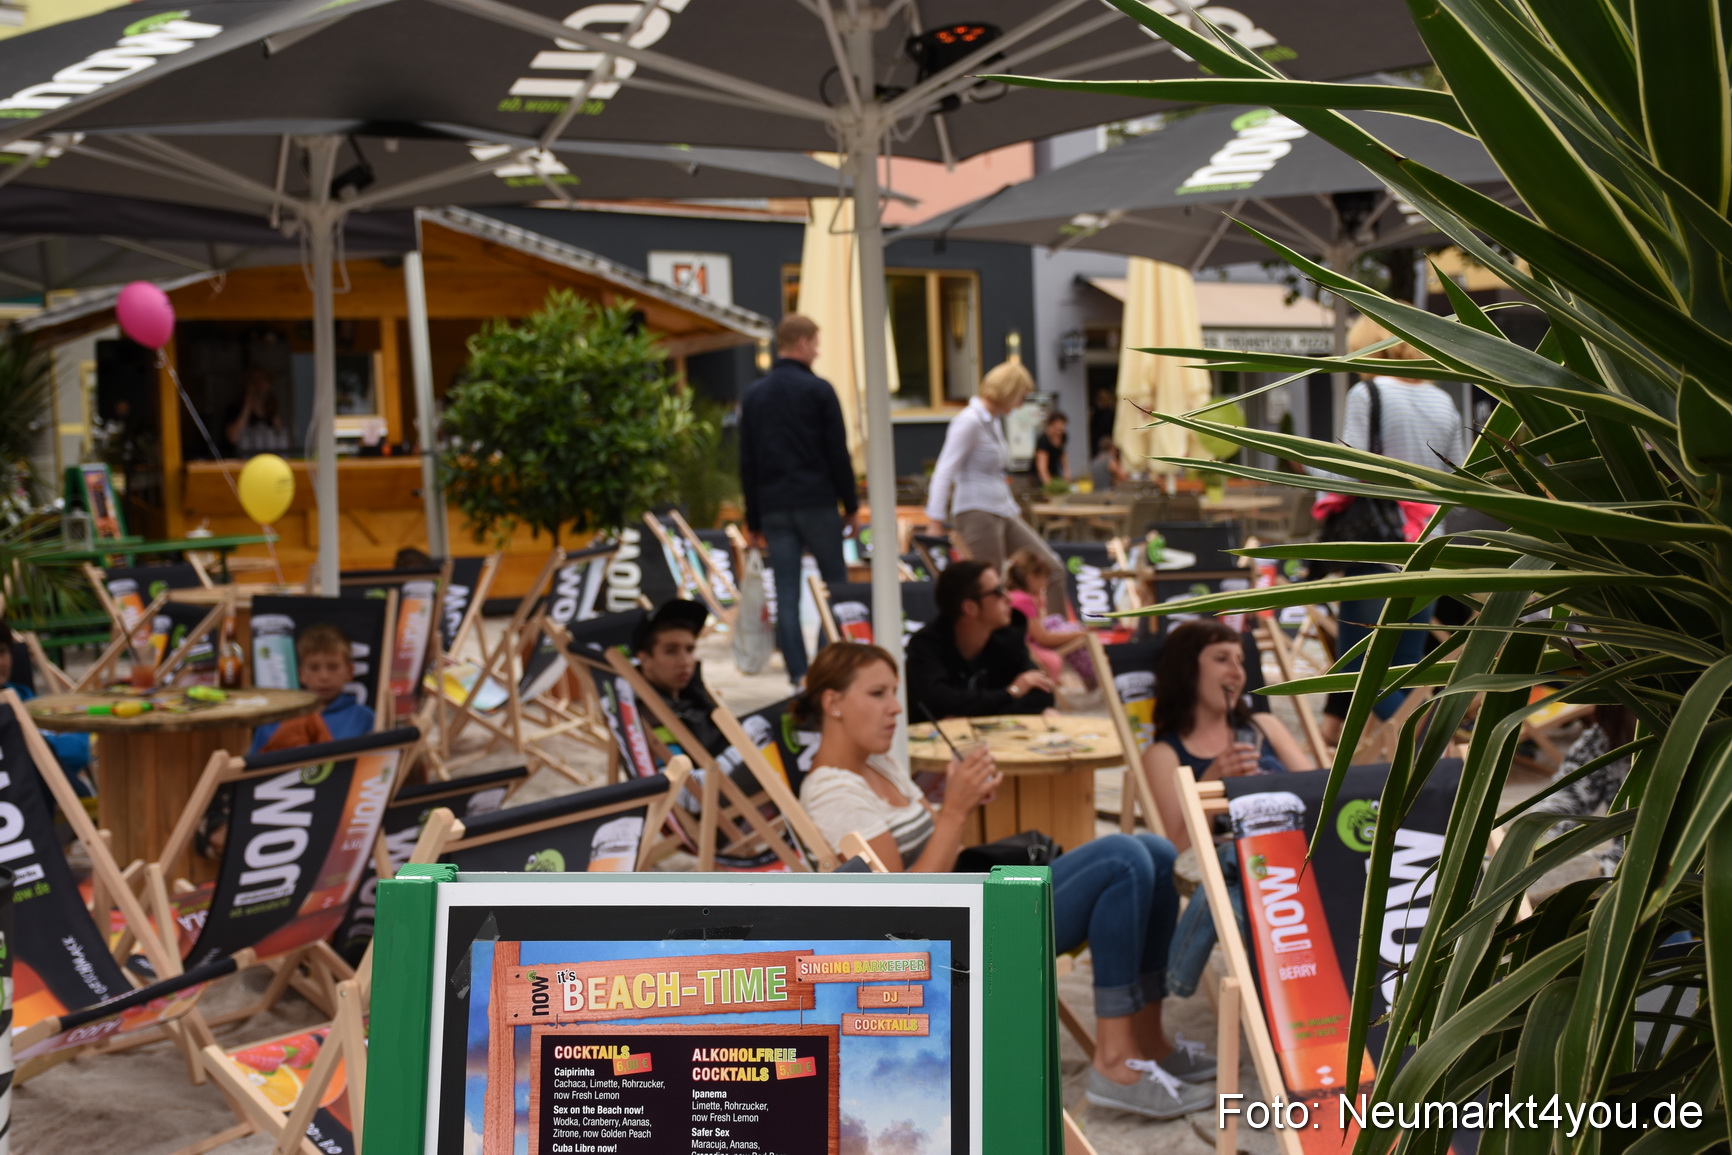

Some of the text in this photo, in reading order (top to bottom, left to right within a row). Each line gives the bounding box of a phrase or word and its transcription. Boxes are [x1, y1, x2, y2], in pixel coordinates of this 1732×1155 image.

[1257, 865, 1312, 954] now
[801, 959, 926, 975] SINGING BARKEEPER
[1279, 963, 1317, 982] BERRY
[530, 973, 550, 1017] now
[563, 966, 788, 1012] BEACH-TIME
[883, 991, 899, 1003] DJ
[854, 1019, 919, 1032] COCKTAILS
[554, 1045, 631, 1060] COCKTAILS
[692, 1047, 797, 1062] ALKOHOLFREIE
[616, 1058, 639, 1072] 6,00
[779, 1063, 802, 1076] 5,00
[554, 1067, 595, 1078] Caipirinha
[692, 1067, 770, 1082] COCKTAILS
[553, 1079, 666, 1089] Cachaca, Limette, Rohrzucker,
[553, 1090, 620, 1100] now Fresh Lemon
[692, 1089, 727, 1099] Ipanema
[553, 1105, 568, 1114] Sex
[582, 1105, 595, 1114] the
[597, 1105, 622, 1114] Beach
[624, 1105, 644, 1114] now!
[691, 1101, 769, 1112] Limette, Rohrzucker,
[553, 1117, 652, 1128] Wodka, Cranberry, Ananas,
[691, 1112, 759, 1122] now Fresh Lemon
[552, 1128, 652, 1139] Zitrone, now Golden Peach
[691, 1127, 730, 1137] Safer Sex
[552, 1143, 617, 1153] Cuba Libre now!
[691, 1139, 760, 1150] Maracuja, Ananas,
